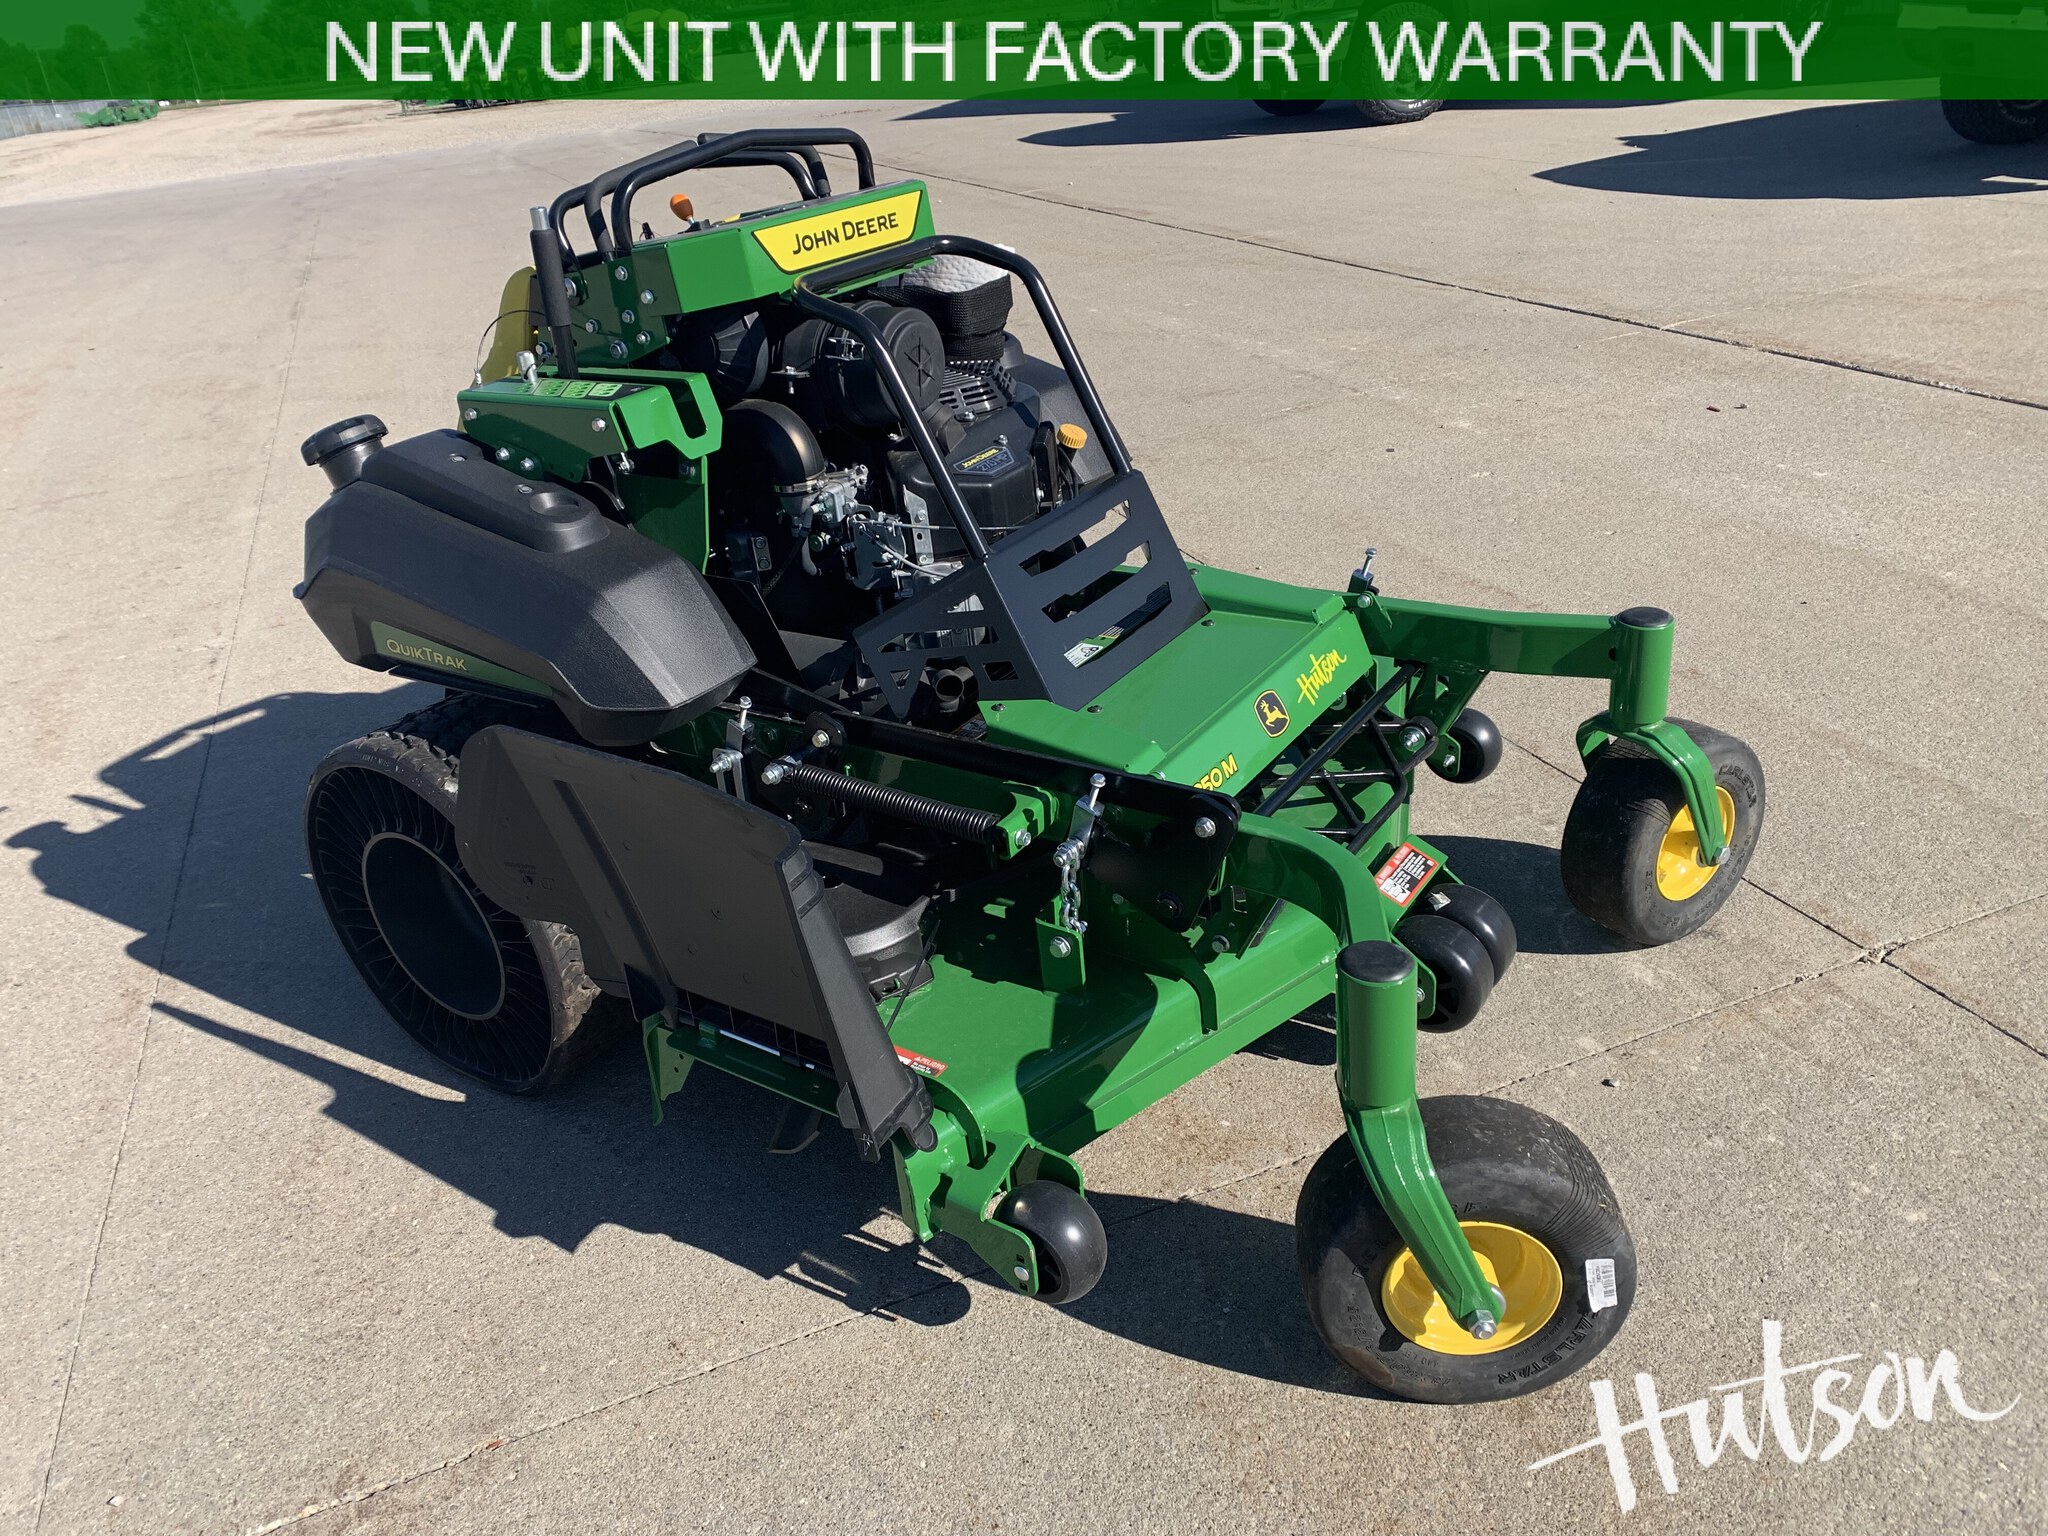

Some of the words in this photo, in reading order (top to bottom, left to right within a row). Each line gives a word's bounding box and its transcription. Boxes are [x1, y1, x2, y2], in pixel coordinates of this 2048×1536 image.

[792, 226, 840, 255] JOHN
[841, 212, 899, 241] DEERE
[1295, 648, 1347, 706] Hutson
